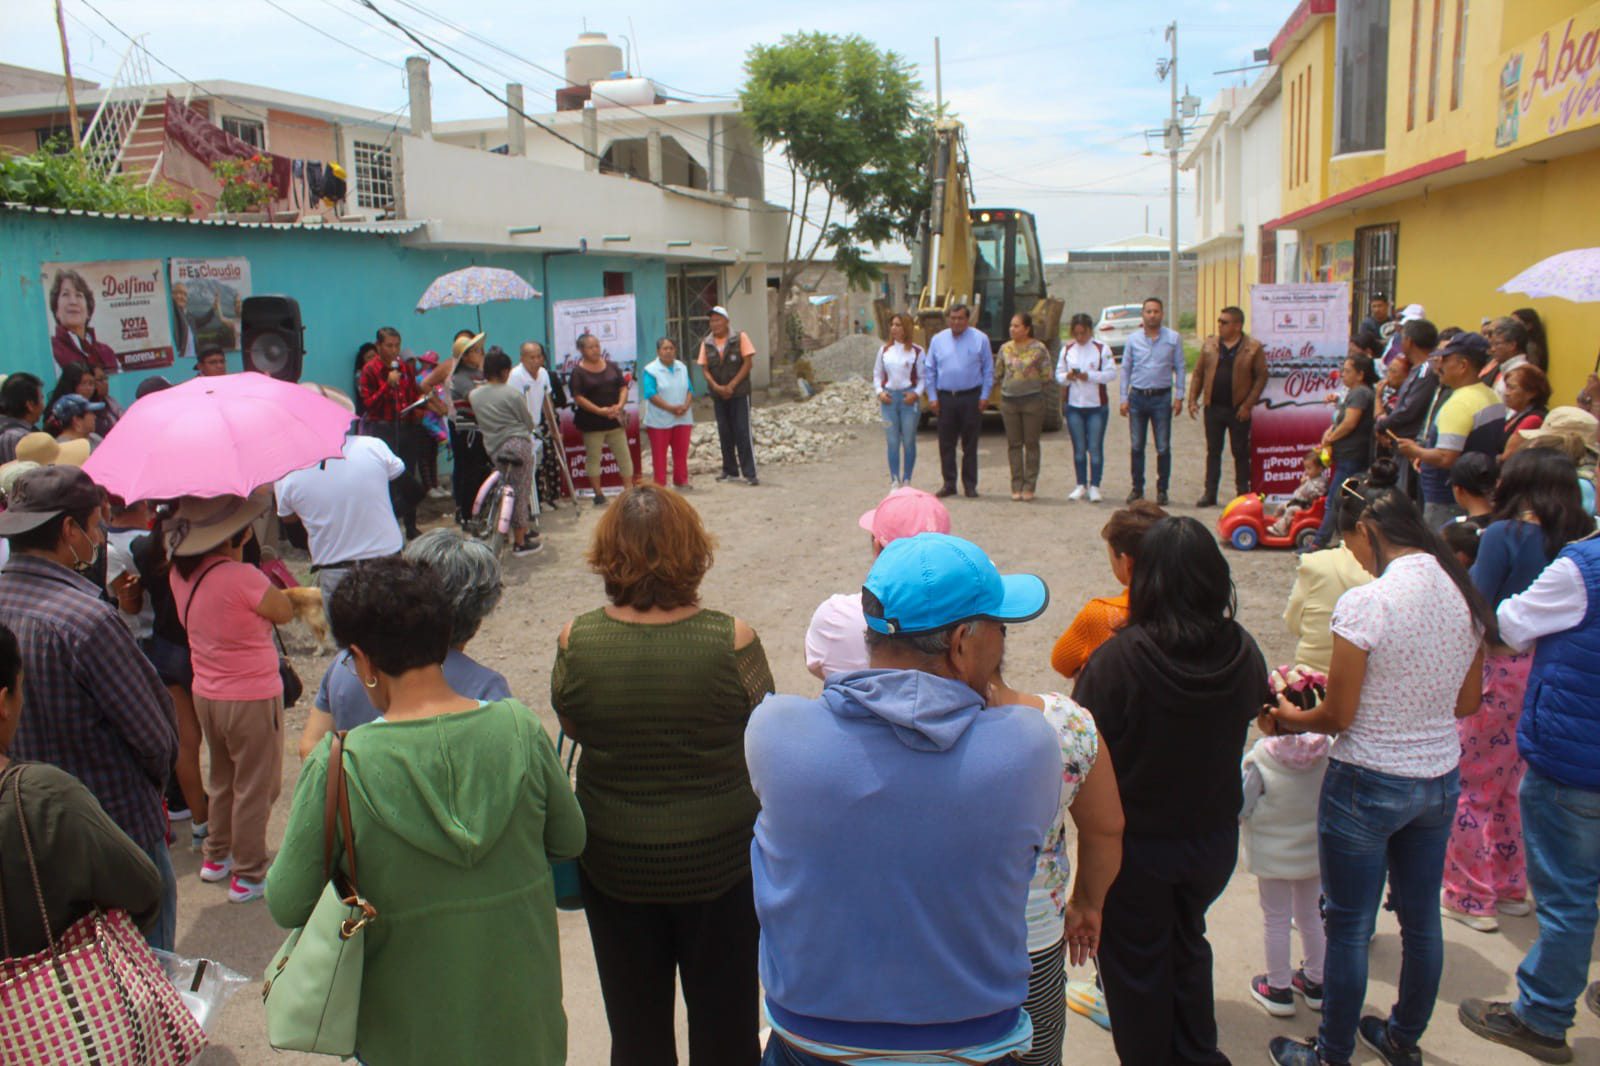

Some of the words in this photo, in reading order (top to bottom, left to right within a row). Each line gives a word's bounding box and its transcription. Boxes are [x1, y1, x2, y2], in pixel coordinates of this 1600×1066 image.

[1521, 17, 1600, 113] Aba
[178, 264, 241, 278] #EsClaudia
[102, 274, 154, 299] Delfina
[120, 316, 147, 328] VOTA
[124, 351, 155, 364] morena
[1300, 342, 1314, 358] de
[1284, 370, 1338, 398] Obra
[1263, 457, 1304, 469] ¡¡Progr
